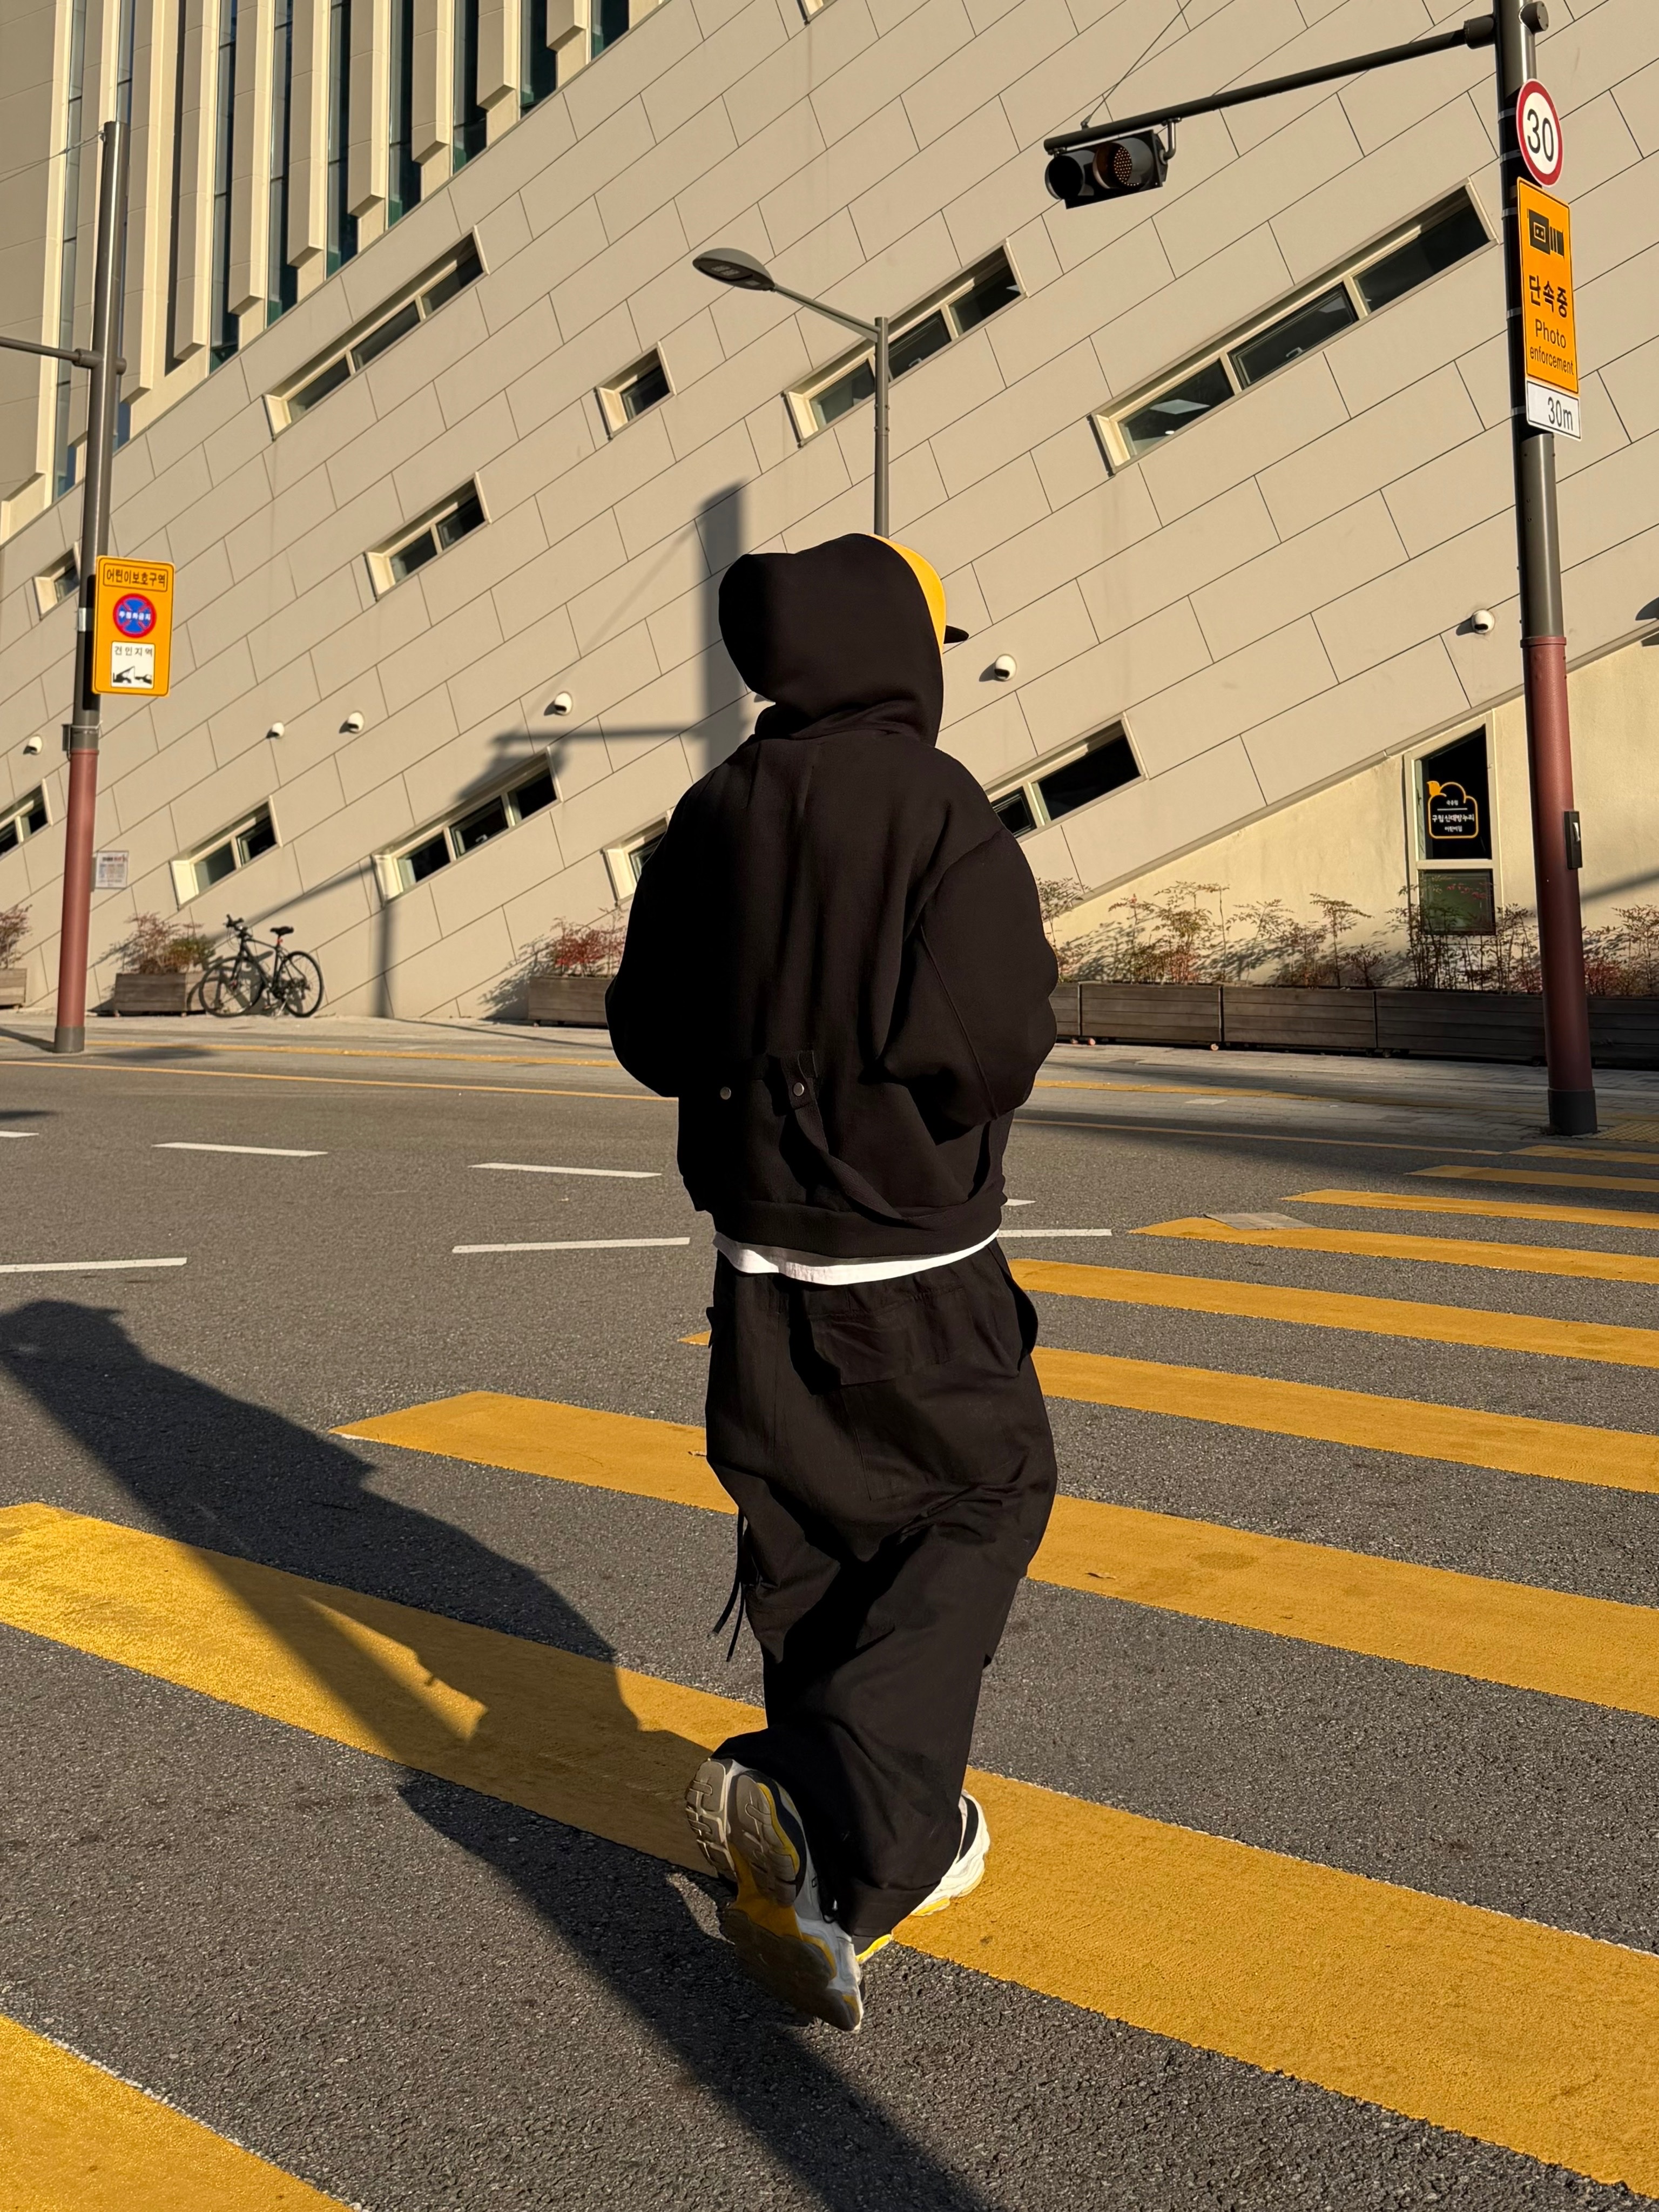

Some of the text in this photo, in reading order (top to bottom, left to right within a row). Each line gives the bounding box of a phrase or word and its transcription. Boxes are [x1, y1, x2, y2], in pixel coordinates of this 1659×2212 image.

[1527, 108, 1554, 162] 30
[1529, 275, 1568, 318] 단속중
[1535, 319, 1566, 348] Photo
[1529, 345, 1574, 375] enforcement
[1548, 396, 1574, 431] 30m
[106, 568, 166, 588] 어린이보호구역
